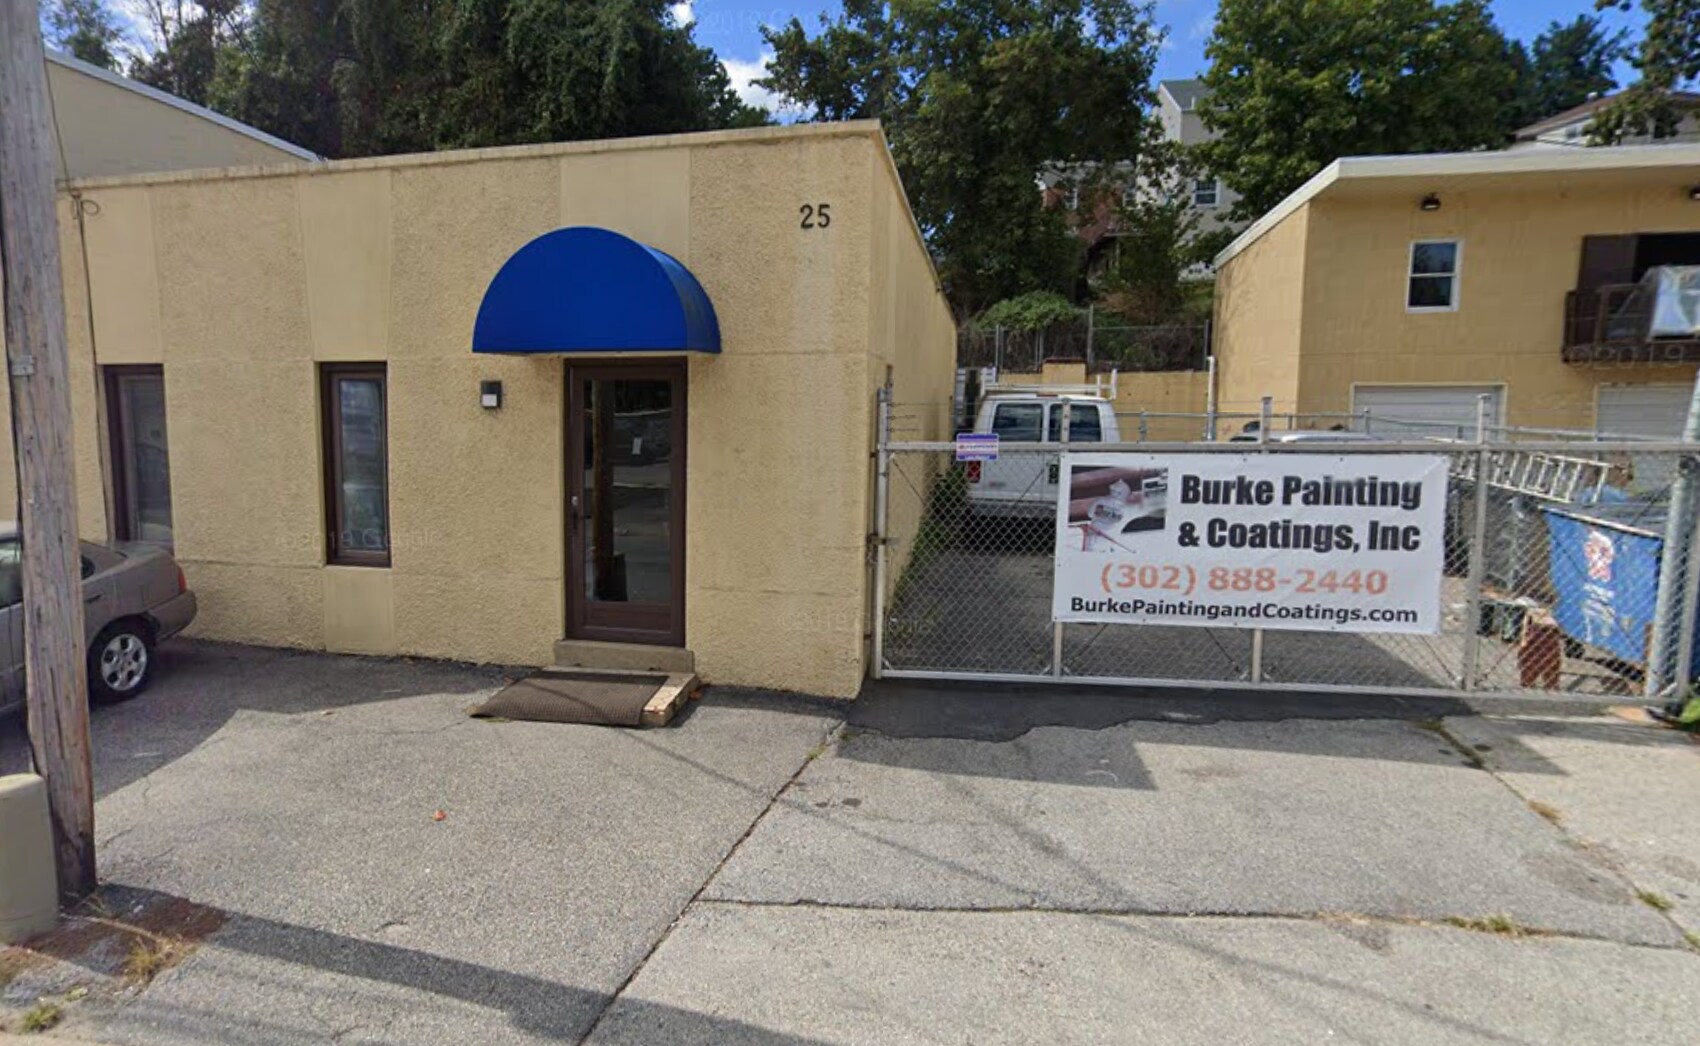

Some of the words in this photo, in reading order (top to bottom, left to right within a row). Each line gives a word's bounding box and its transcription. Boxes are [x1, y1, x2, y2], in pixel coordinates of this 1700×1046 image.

[800, 203, 831, 229] 25
[1180, 474, 1275, 505] Burke
[1282, 475, 1423, 510] Painting
[1178, 521, 1200, 547] &
[1207, 518, 1360, 553] Coatings,
[1368, 520, 1421, 551] Inc
[1101, 563, 1197, 595] (302)
[1208, 565, 1389, 595] 888-2440
[1070, 597, 1419, 623] BurkePaintingandCoatings.com
